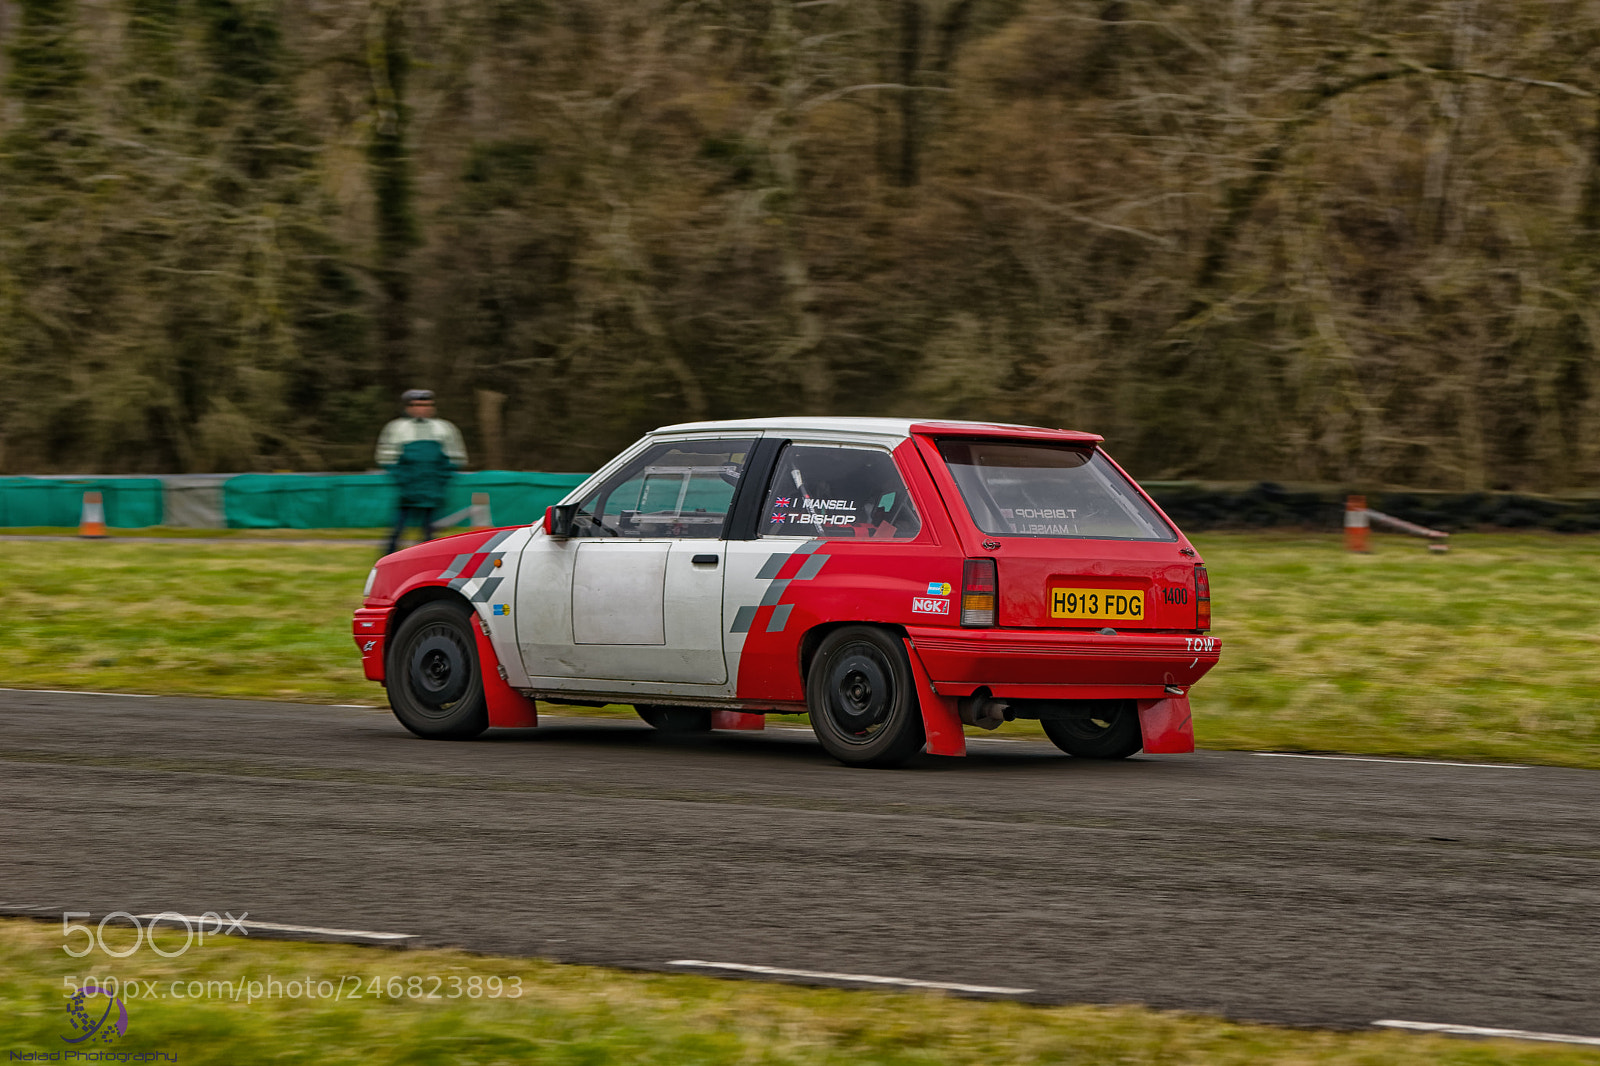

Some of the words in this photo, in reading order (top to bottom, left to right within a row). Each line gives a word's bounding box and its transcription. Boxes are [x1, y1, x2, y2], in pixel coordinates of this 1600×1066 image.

[802, 498, 857, 511] MANSELL
[788, 513, 856, 526] T.BISHOP
[1162, 587, 1188, 605] 1400
[914, 599, 942, 613] NGK
[1053, 592, 1099, 615] H913
[1105, 594, 1142, 616] FDG
[1185, 637, 1215, 652] TOW
